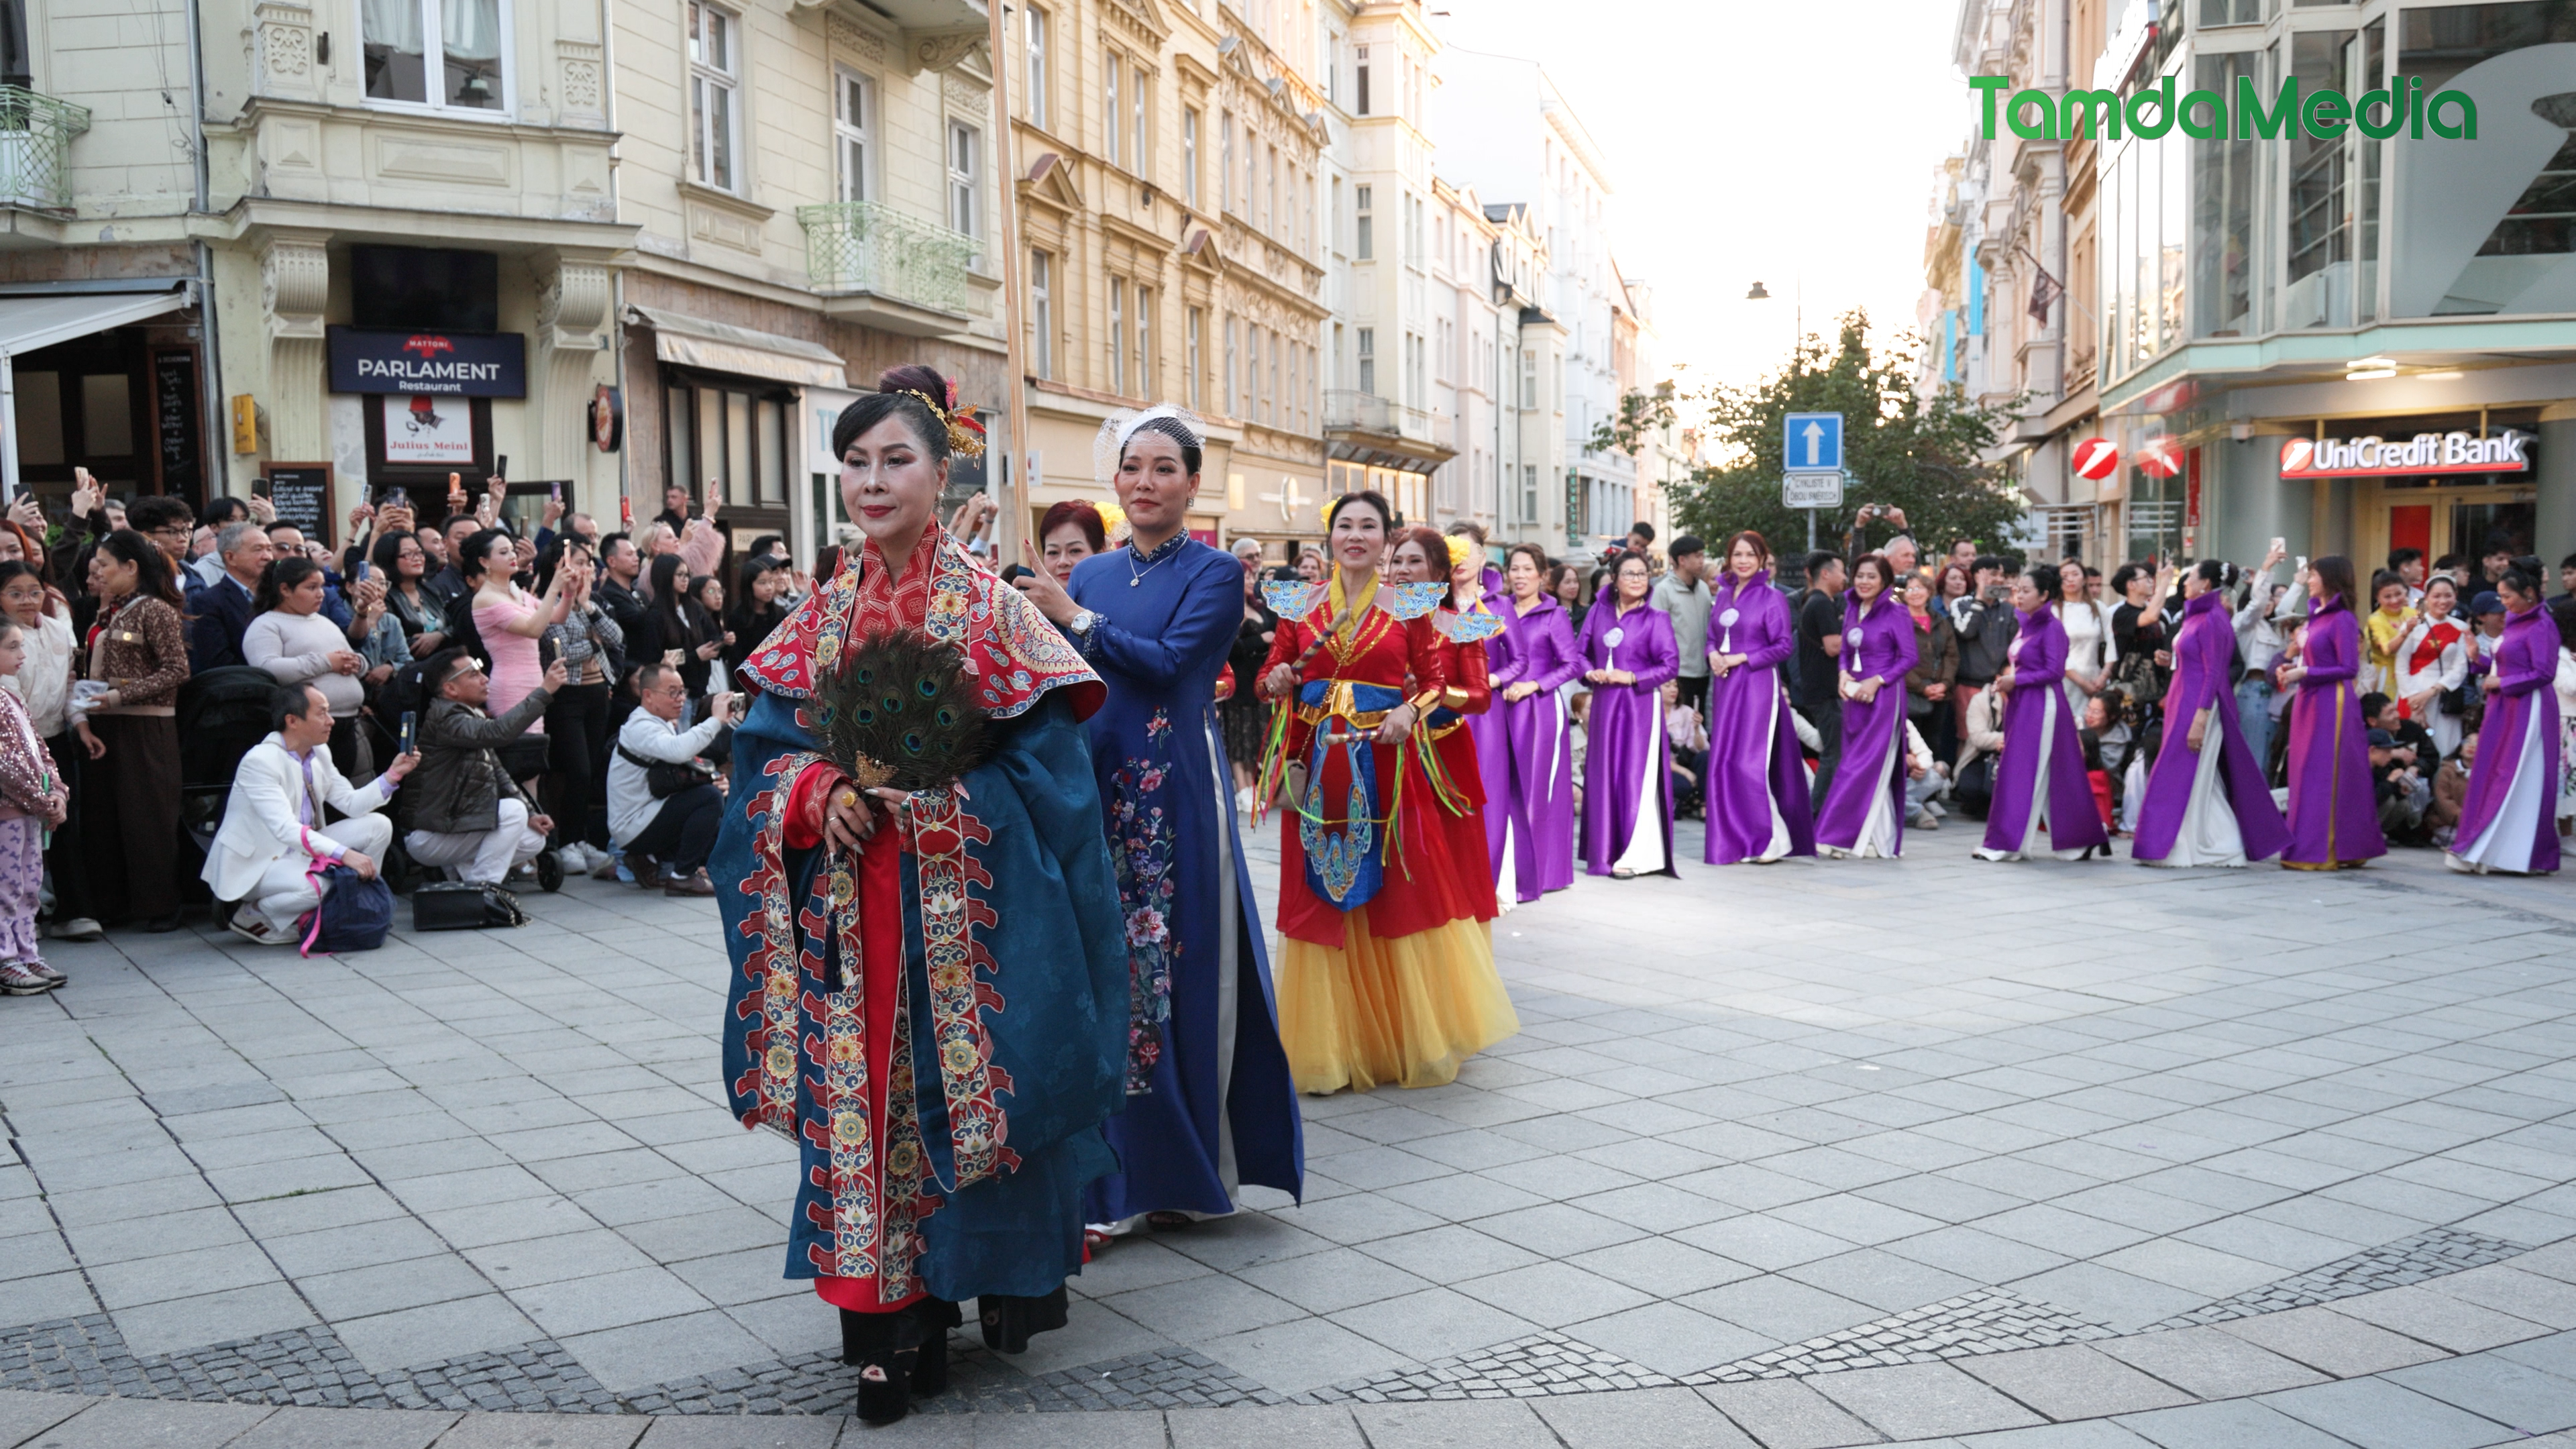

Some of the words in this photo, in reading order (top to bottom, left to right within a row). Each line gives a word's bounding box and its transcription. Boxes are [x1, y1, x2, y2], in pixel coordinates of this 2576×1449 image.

[409, 339, 448, 348] MATTONI
[358, 359, 500, 380] PARLAMENT
[399, 380, 462, 392] Restaurant
[390, 440, 429, 450] Julius
[434, 441, 468, 450] Meinl
[2314, 433, 2440, 470] UniCredit
[2445, 430, 2522, 464] Bank
